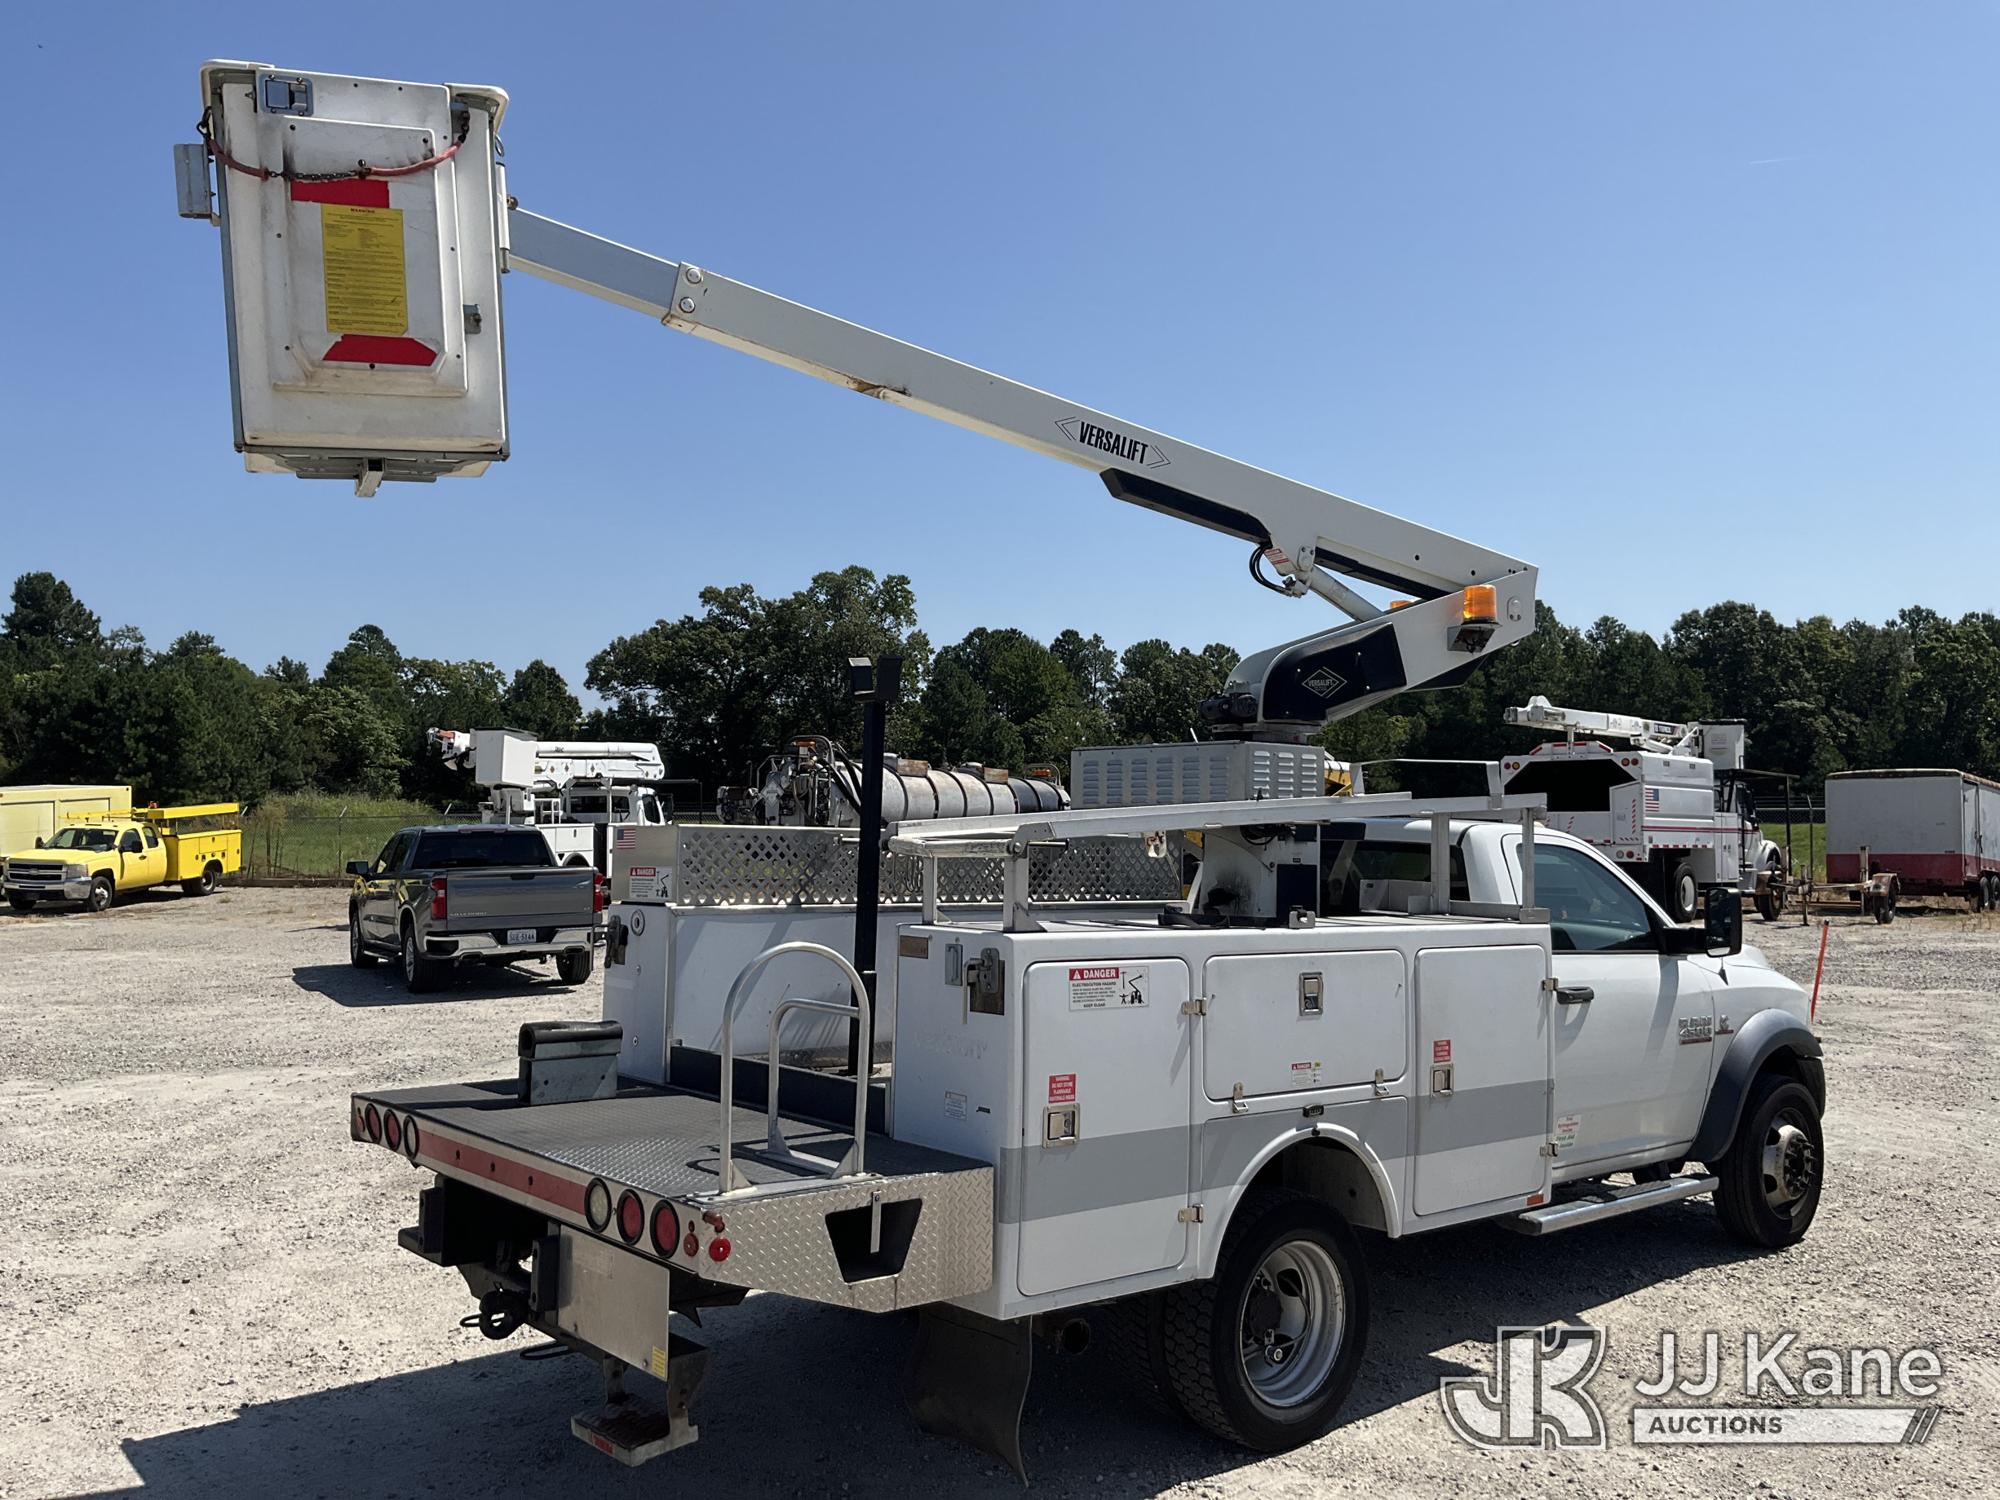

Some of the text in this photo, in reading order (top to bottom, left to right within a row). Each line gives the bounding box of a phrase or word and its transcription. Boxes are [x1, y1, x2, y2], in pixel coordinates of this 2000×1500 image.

[1079, 421, 1149, 464] VERSALIFT
[1083, 968, 1116, 979] DANGER
[1679, 1015, 1712, 1028] RAM
